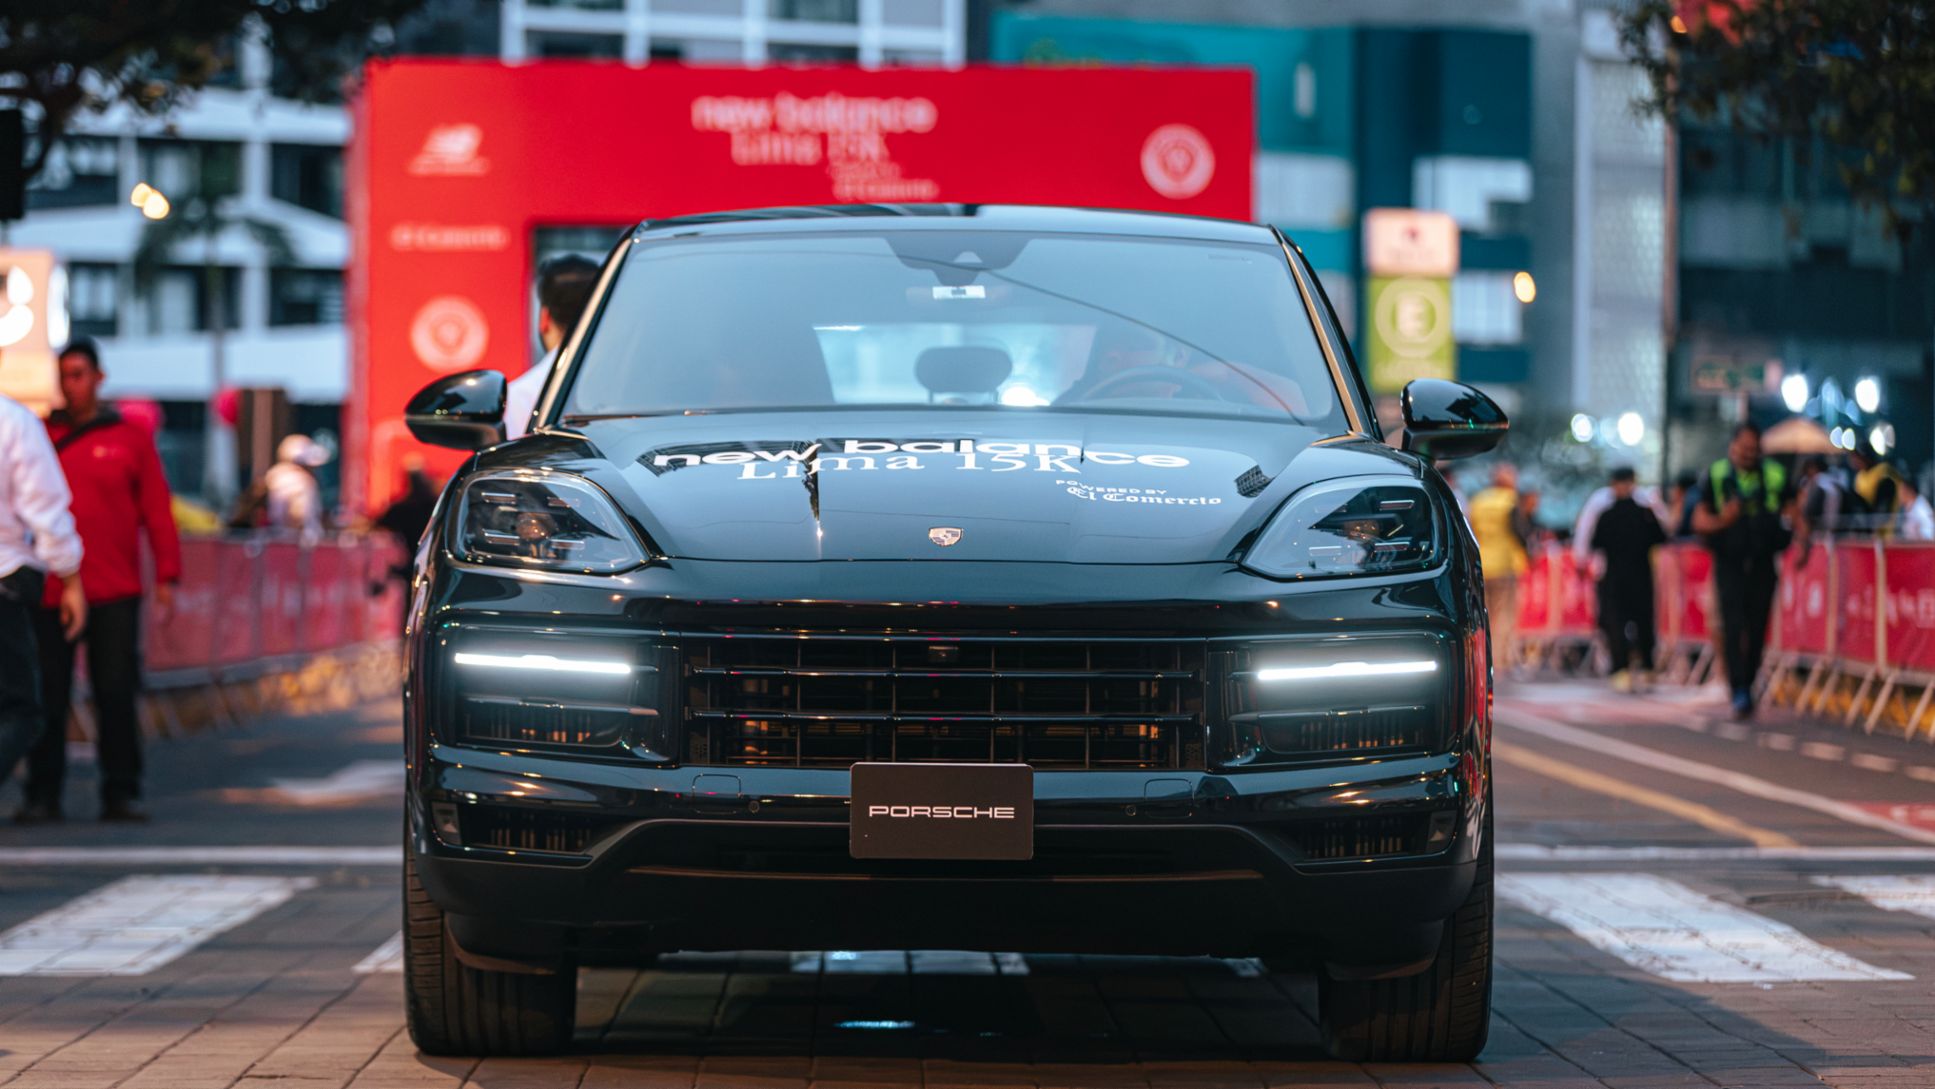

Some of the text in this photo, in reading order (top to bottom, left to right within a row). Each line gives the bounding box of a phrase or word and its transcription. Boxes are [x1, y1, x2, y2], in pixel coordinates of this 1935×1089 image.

[654, 440, 1190, 468] new balance
[737, 452, 1082, 480] Lima 15K
[1055, 479, 1141, 495] POWERED
[1067, 486, 1222, 506] El Comercio
[868, 805, 1015, 819] PORSCHE
